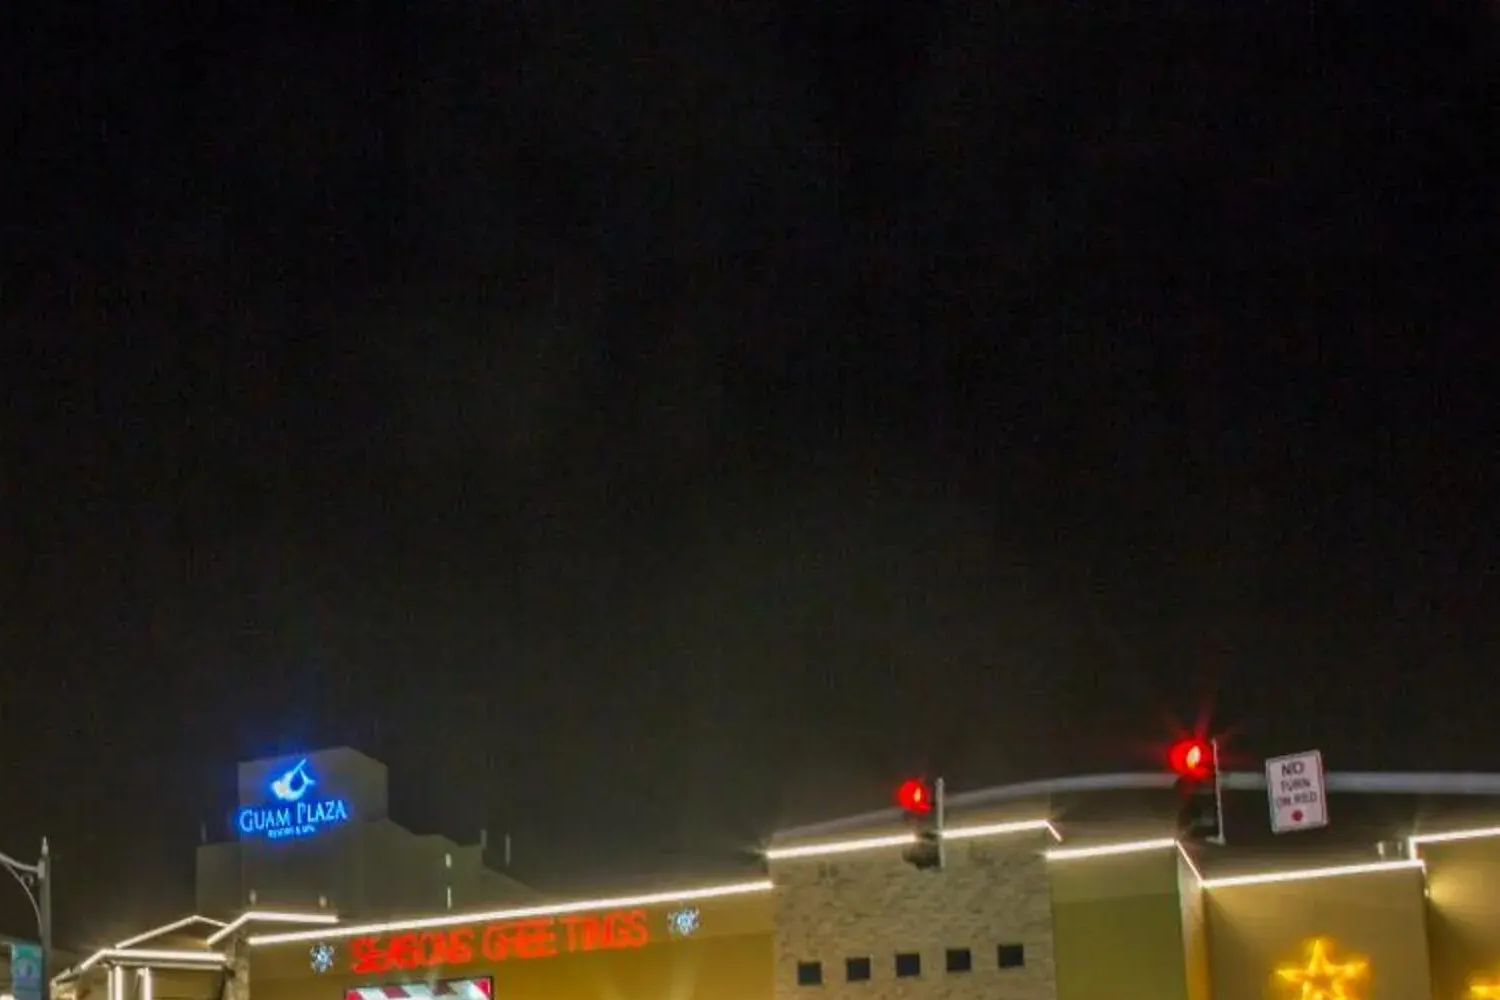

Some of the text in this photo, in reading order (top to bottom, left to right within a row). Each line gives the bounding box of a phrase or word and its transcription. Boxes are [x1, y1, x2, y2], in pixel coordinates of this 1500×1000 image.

[1281, 761, 1305, 777] NO
[1280, 778, 1311, 792] TURN
[1294, 791, 1318, 803] RED
[297, 799, 348, 824] PLAZA
